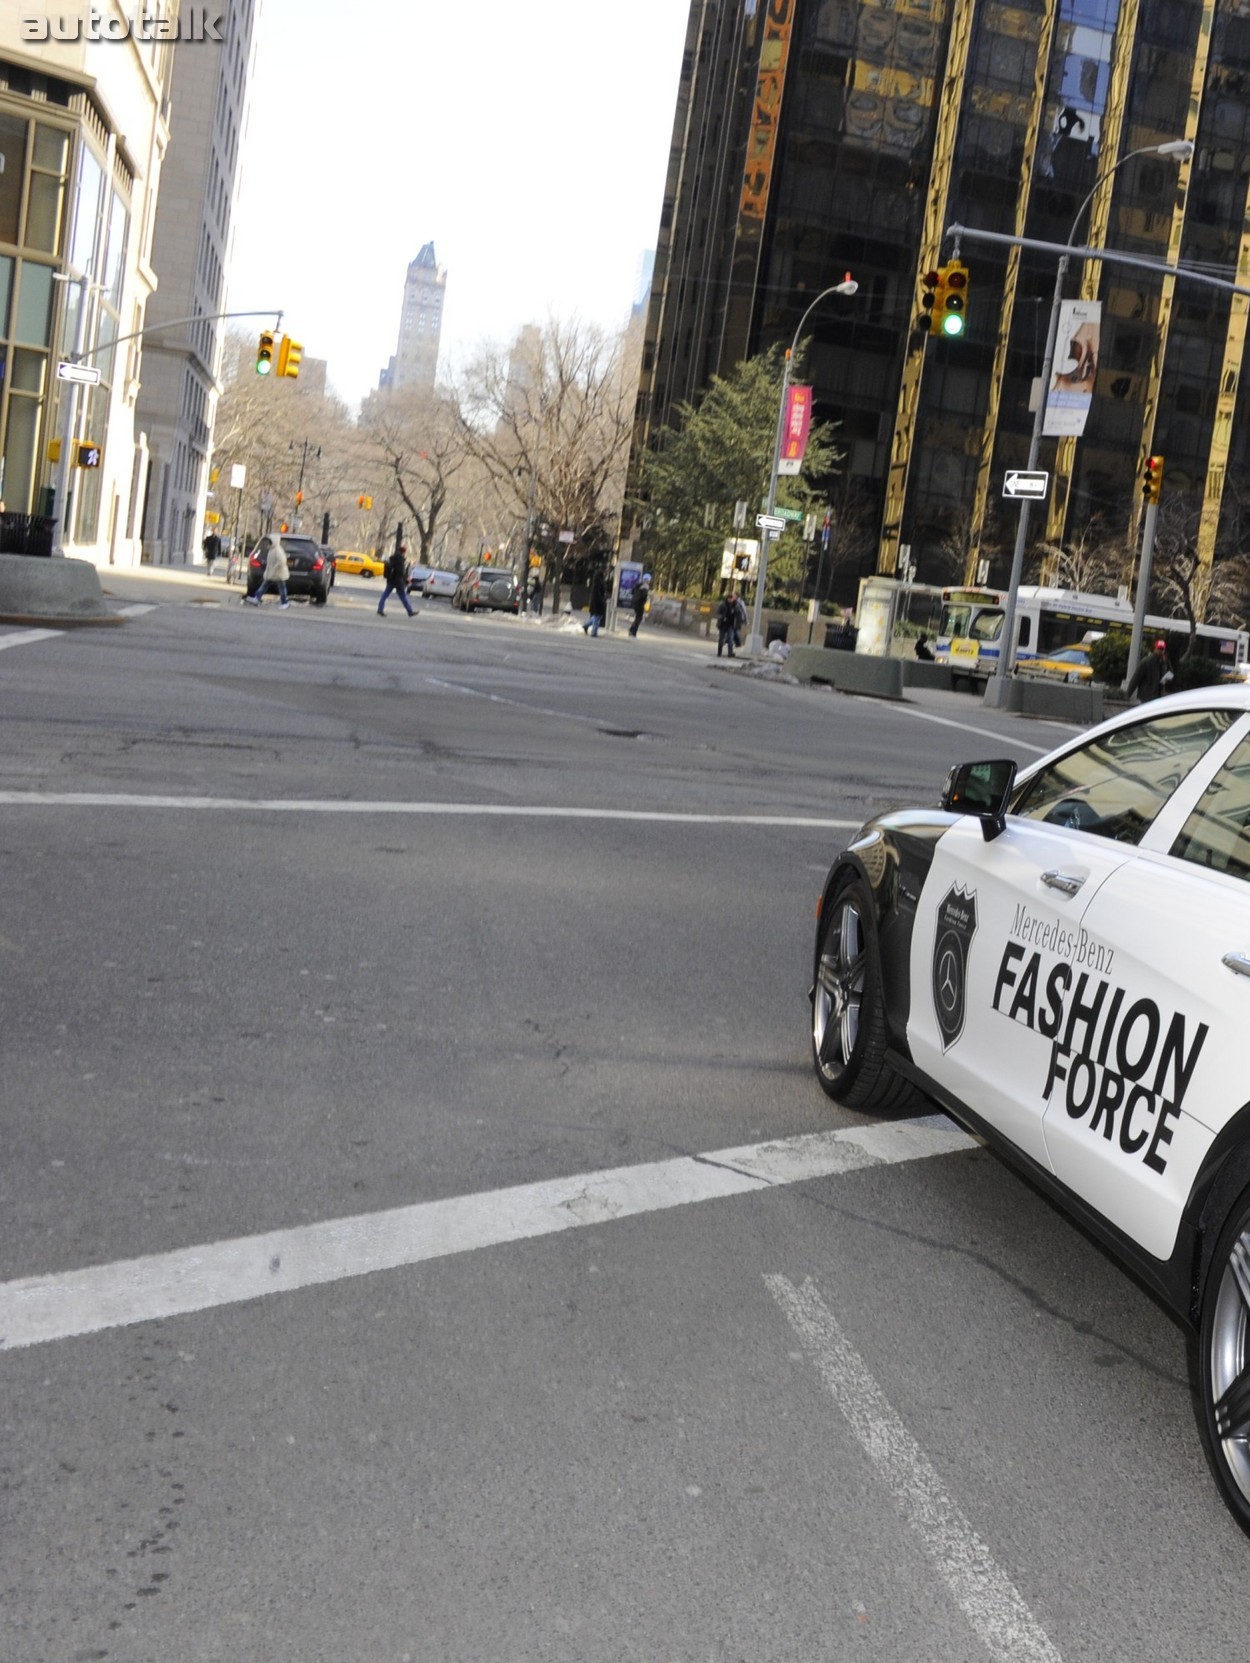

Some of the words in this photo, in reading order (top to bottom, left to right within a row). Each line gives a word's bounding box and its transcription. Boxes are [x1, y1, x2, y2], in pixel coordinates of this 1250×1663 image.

[1009, 903, 1115, 975] Mercedes-Benz
[992, 941, 1210, 1110] FASHION
[1042, 1040, 1183, 1176] FORCE
